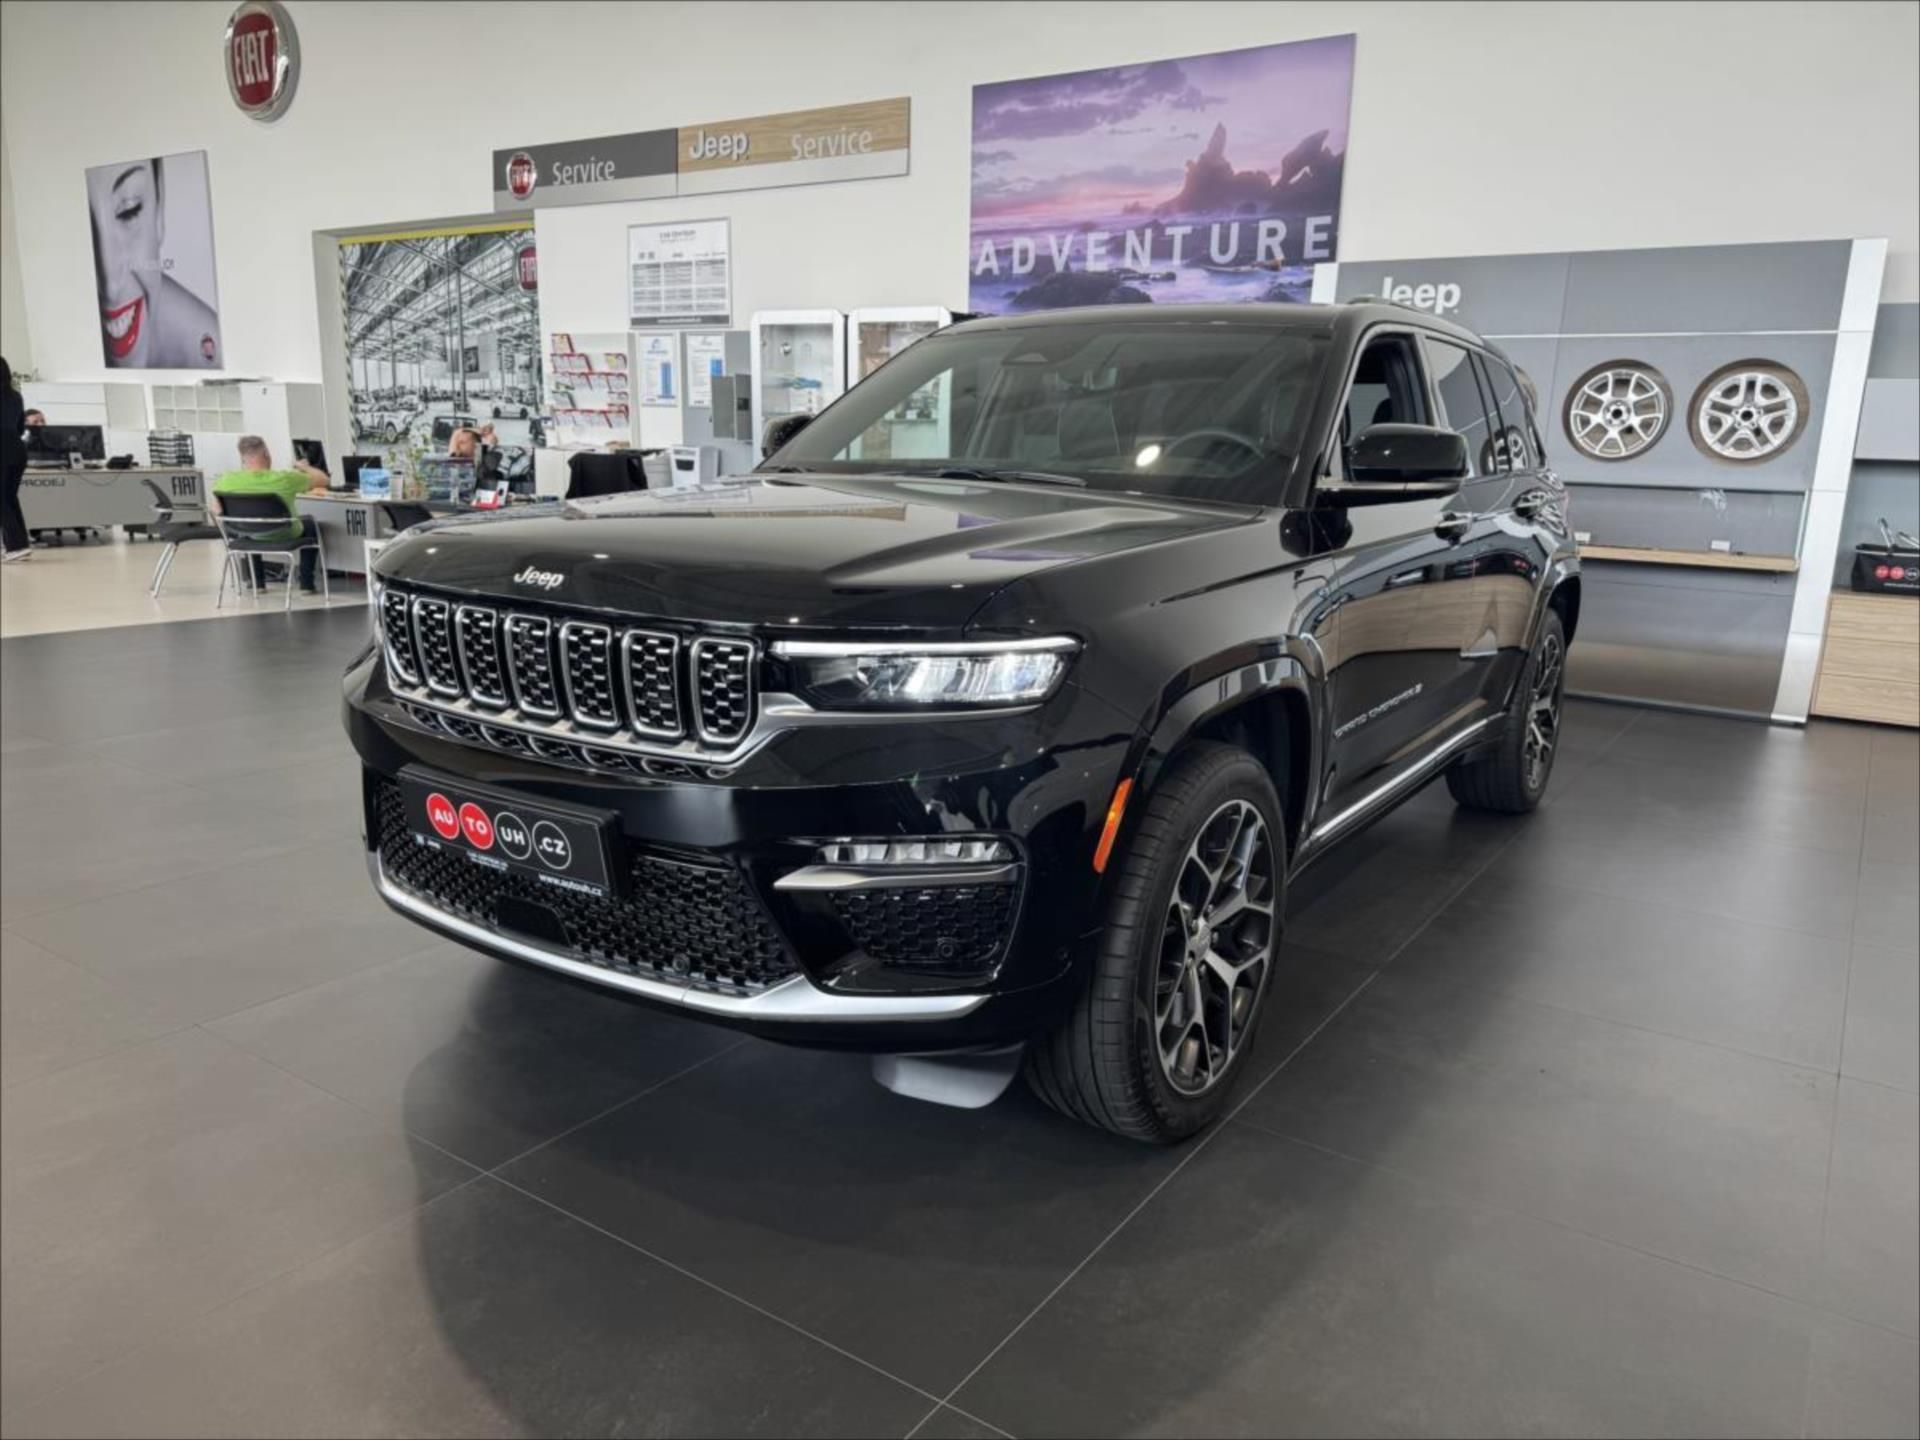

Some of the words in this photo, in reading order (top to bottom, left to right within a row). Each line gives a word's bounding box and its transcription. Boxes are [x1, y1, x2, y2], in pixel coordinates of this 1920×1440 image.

[234, 30, 270, 86] FIAT
[690, 129, 748, 160] Jeep
[791, 127, 872, 160] Service
[552, 157, 615, 186] Service
[974, 214, 1333, 276] ADVENTURE
[520, 256, 537, 282] FIA
[171, 475, 197, 497] FIAT
[346, 509, 367, 537] FIAT
[513, 565, 565, 591] Jeep
[434, 808, 454, 826] AU
[466, 816, 487, 835] TO
[501, 827, 525, 845] UH
[539, 836, 566, 856] .CZ
